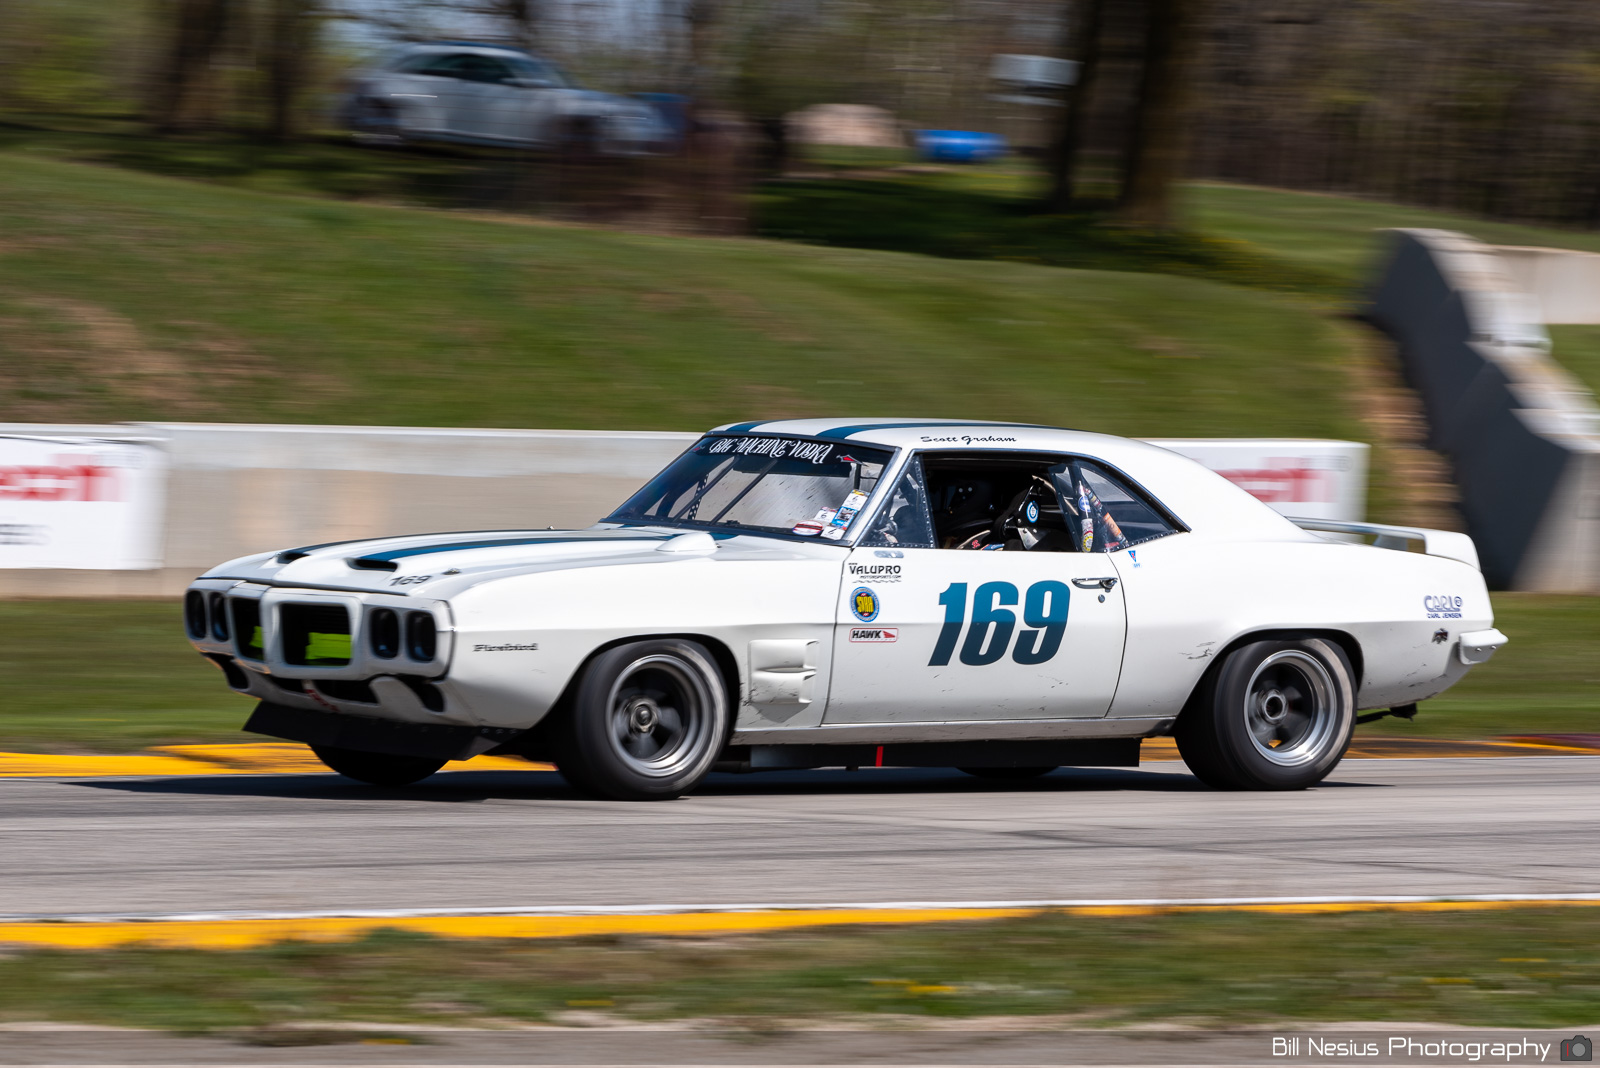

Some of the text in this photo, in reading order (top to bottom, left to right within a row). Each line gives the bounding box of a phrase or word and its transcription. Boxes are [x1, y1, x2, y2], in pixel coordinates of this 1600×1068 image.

[920, 435, 1017, 445] Scott Graham
[849, 565, 901, 575] VALUPRO
[389, 575, 433, 587] 169
[927, 580, 1071, 667] 169
[852, 630, 882, 639] HAWK
